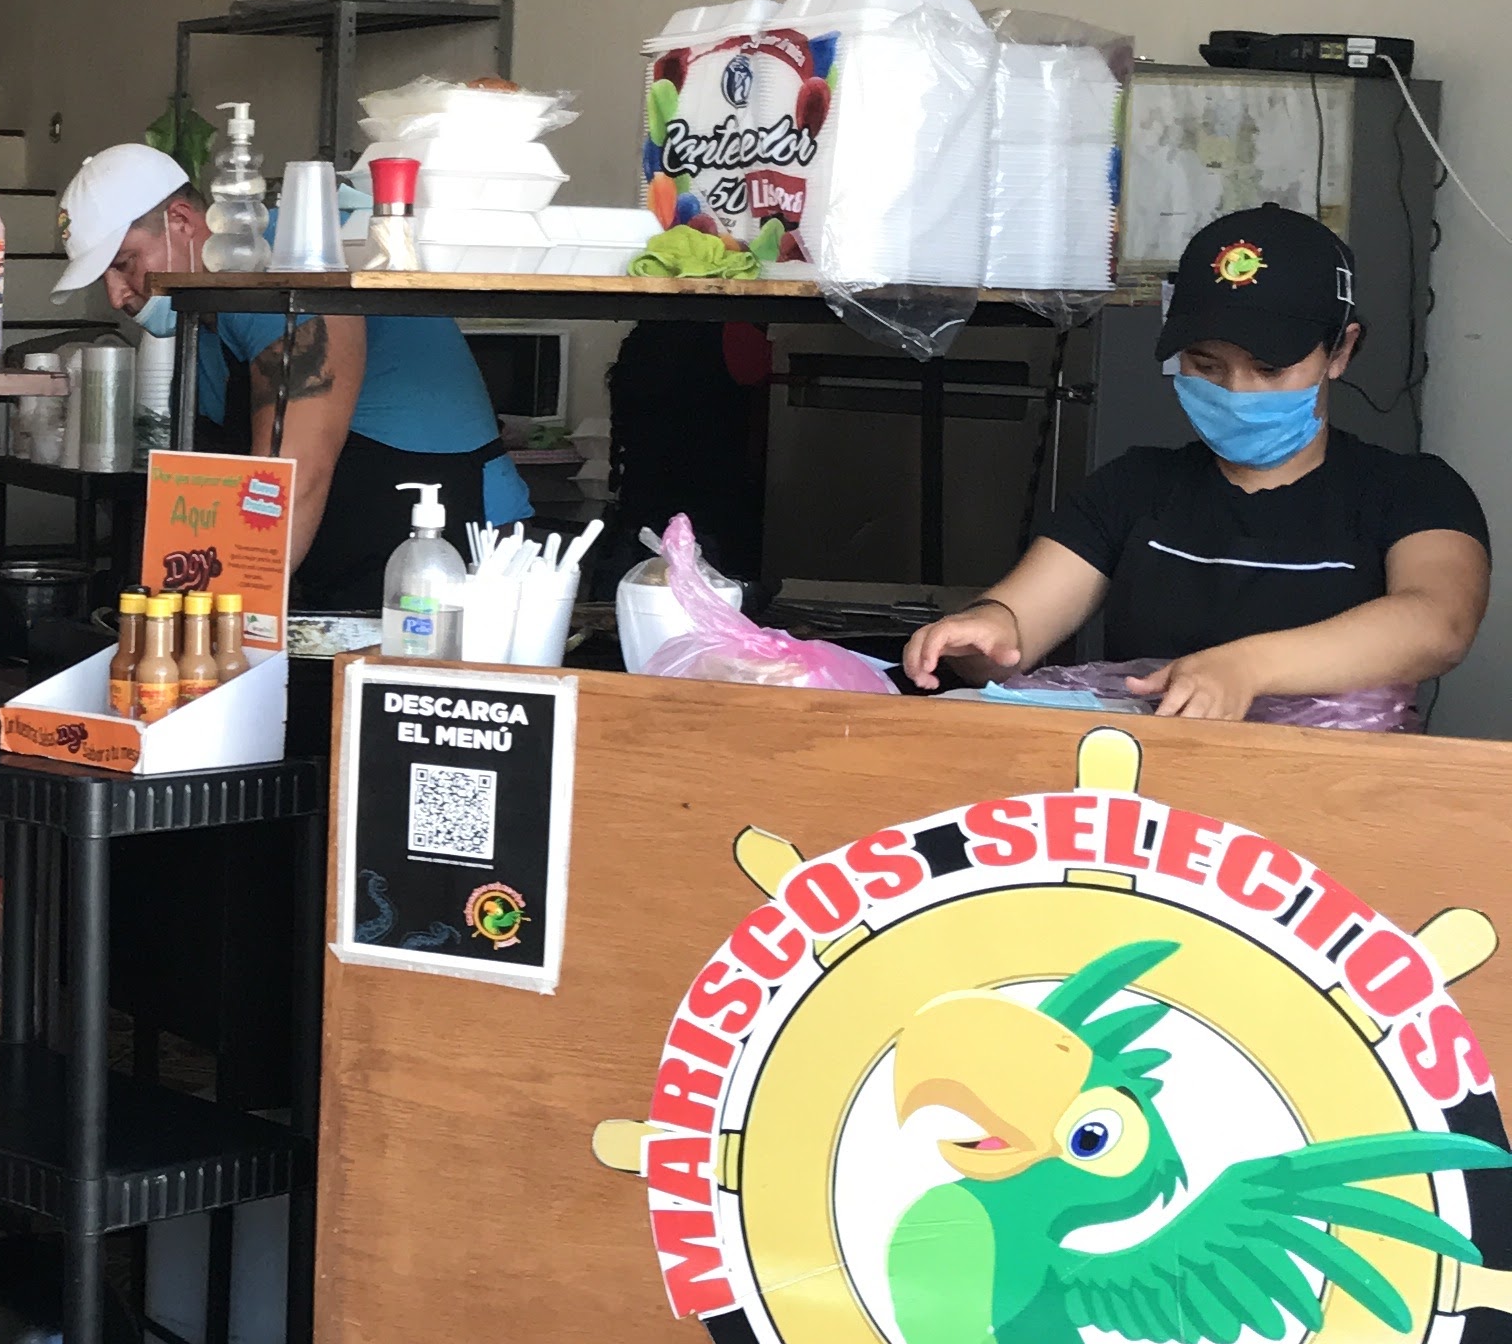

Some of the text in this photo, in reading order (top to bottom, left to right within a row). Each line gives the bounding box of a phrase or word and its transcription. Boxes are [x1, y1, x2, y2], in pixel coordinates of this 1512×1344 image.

[170, 496, 220, 536] Aquí
[384, 692, 529, 726] DESCARGA
[398, 721, 512, 752] EL MENÚ
[648, 795, 1491, 1319] MARISCOS SELECTOS
